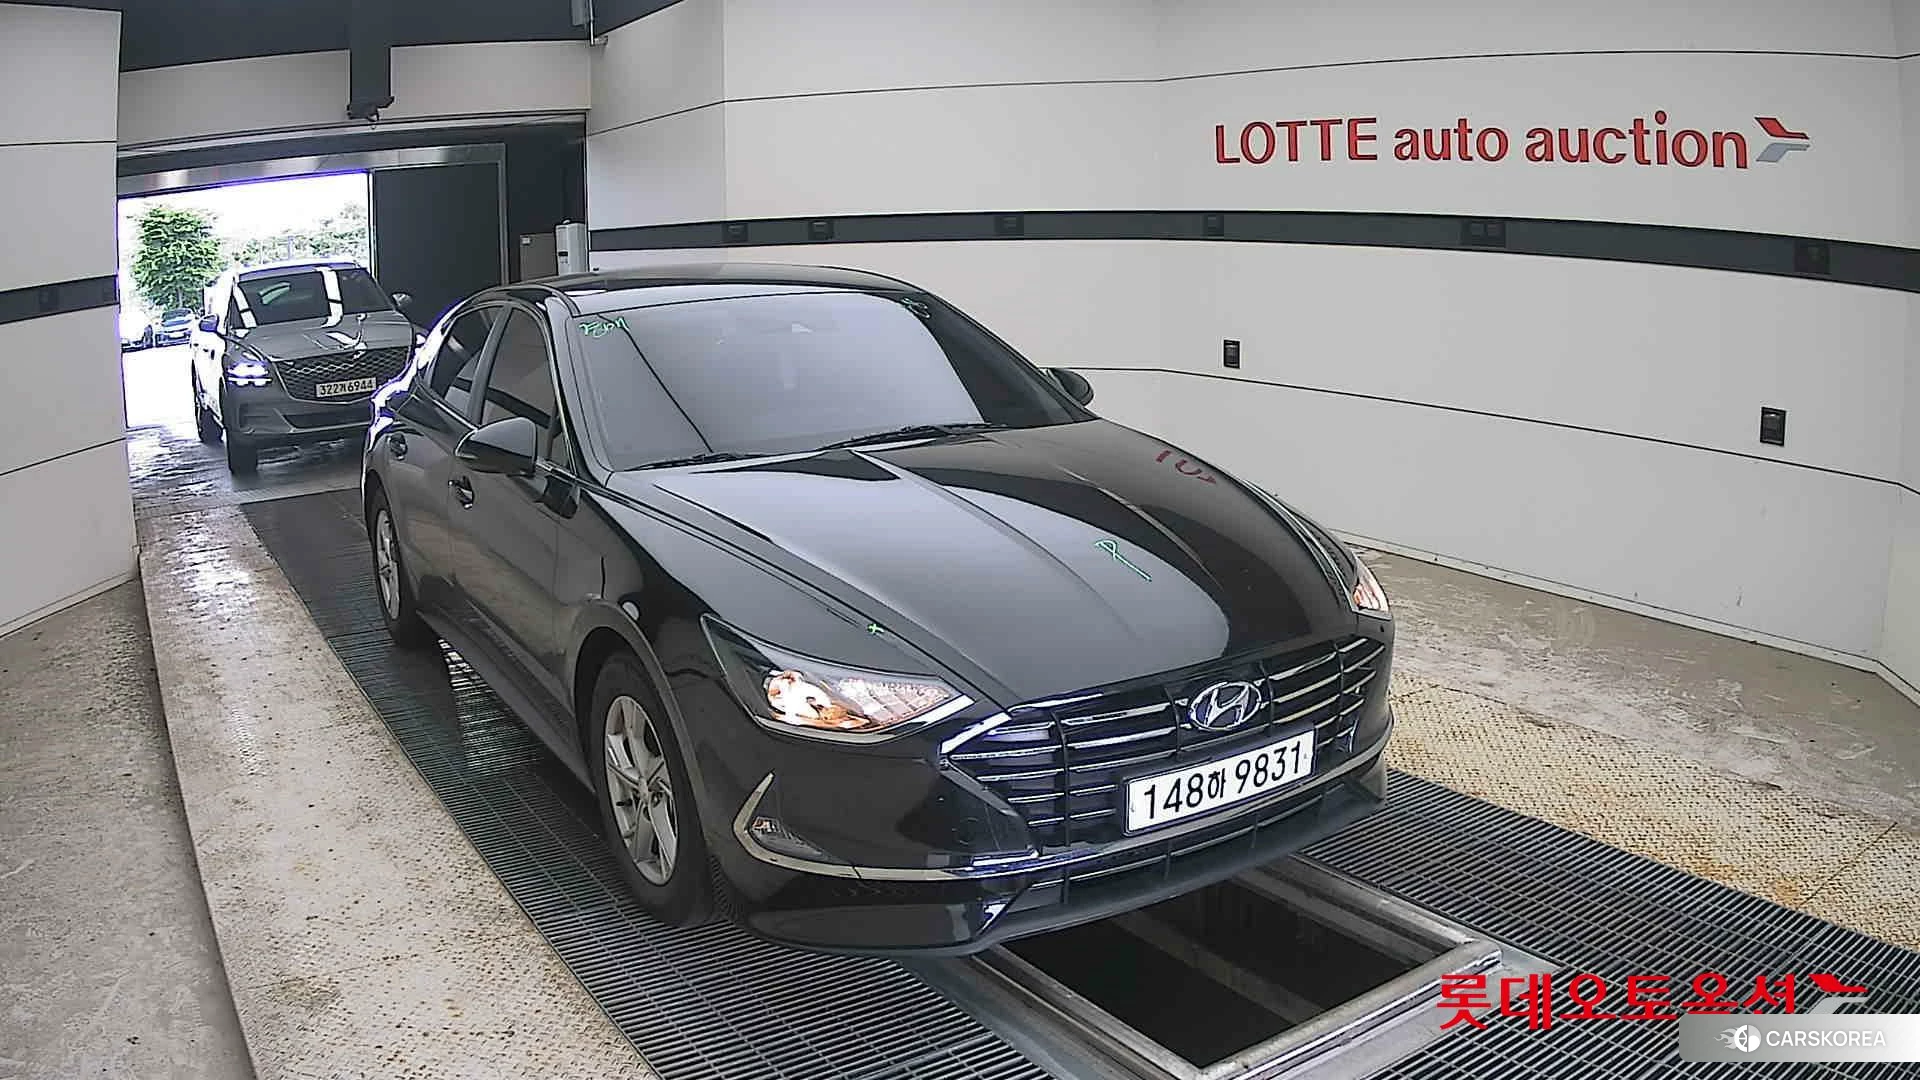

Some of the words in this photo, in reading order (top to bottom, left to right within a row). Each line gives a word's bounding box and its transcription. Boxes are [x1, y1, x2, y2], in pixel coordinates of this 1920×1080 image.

[1215, 118, 1378, 164] LOTTE
[1394, 118, 1509, 162] auto
[1525, 110, 1749, 169] auction
[1144, 767, 1226, 819] 148하
[1235, 740, 1302, 794] 9831
